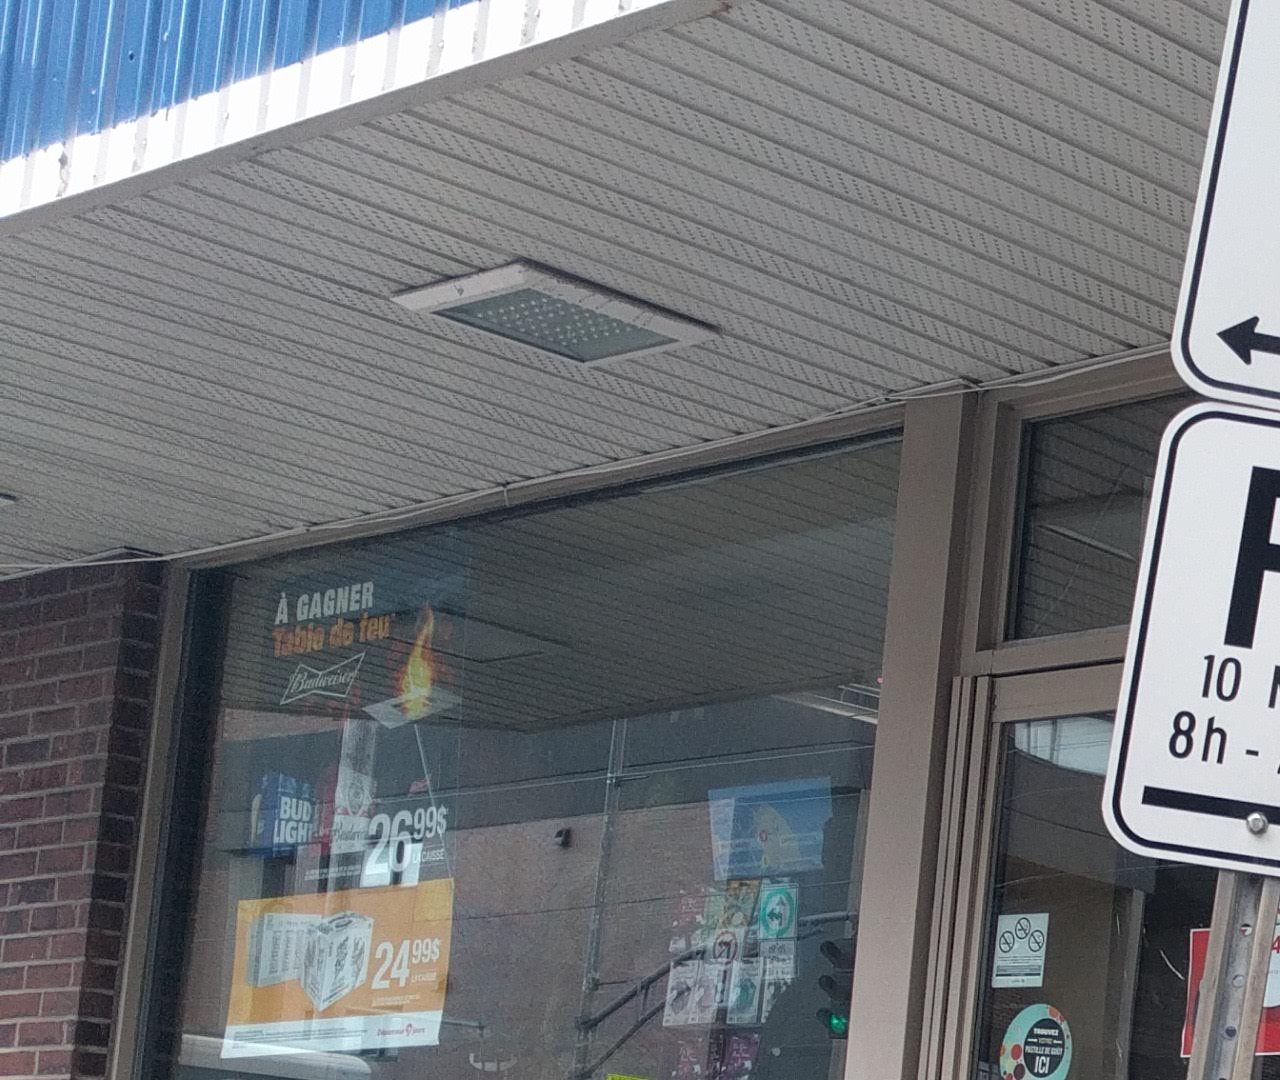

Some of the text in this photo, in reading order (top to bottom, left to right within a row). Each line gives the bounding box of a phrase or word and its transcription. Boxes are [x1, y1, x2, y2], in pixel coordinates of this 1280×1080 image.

[274, 581, 375, 625] À GAGNER
[329, 617, 355, 648] de
[289, 667, 357, 694] Budweiser
[1201, 654, 1243, 703] 10
[1167, 710, 1229, 766] 8h
[279, 796, 312, 822] BUD
[1034, 1056, 1051, 1074] ICI
